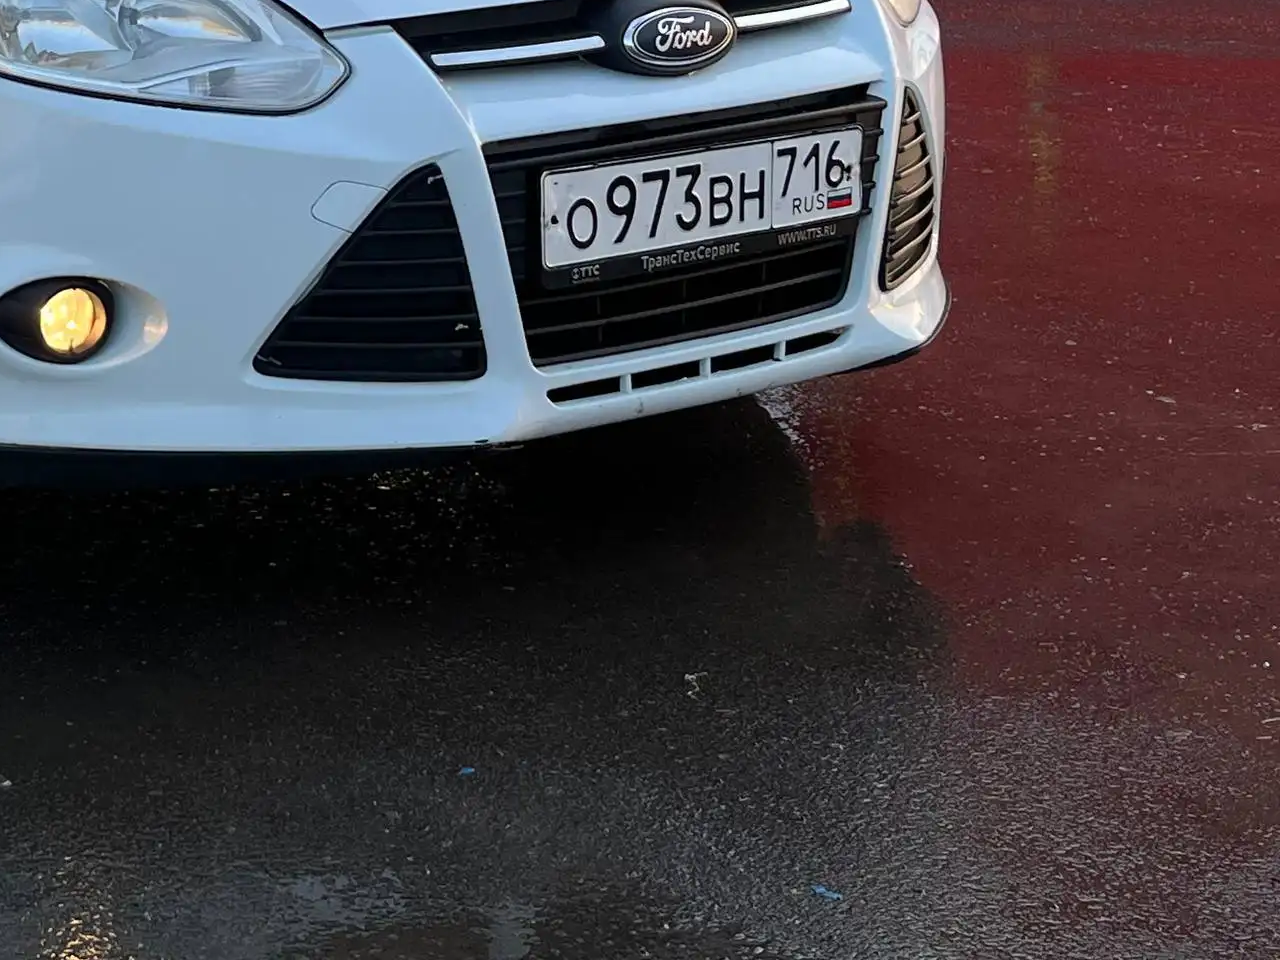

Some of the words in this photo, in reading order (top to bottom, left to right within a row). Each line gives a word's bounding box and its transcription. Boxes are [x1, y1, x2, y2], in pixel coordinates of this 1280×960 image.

[655, 16, 713, 52] Ford
[776, 140, 846, 198] 716
[792, 193, 825, 216] RUS
[777, 224, 837, 246] WWW.TTS.RU
[641, 242, 741, 272] ТрансТехСервис
